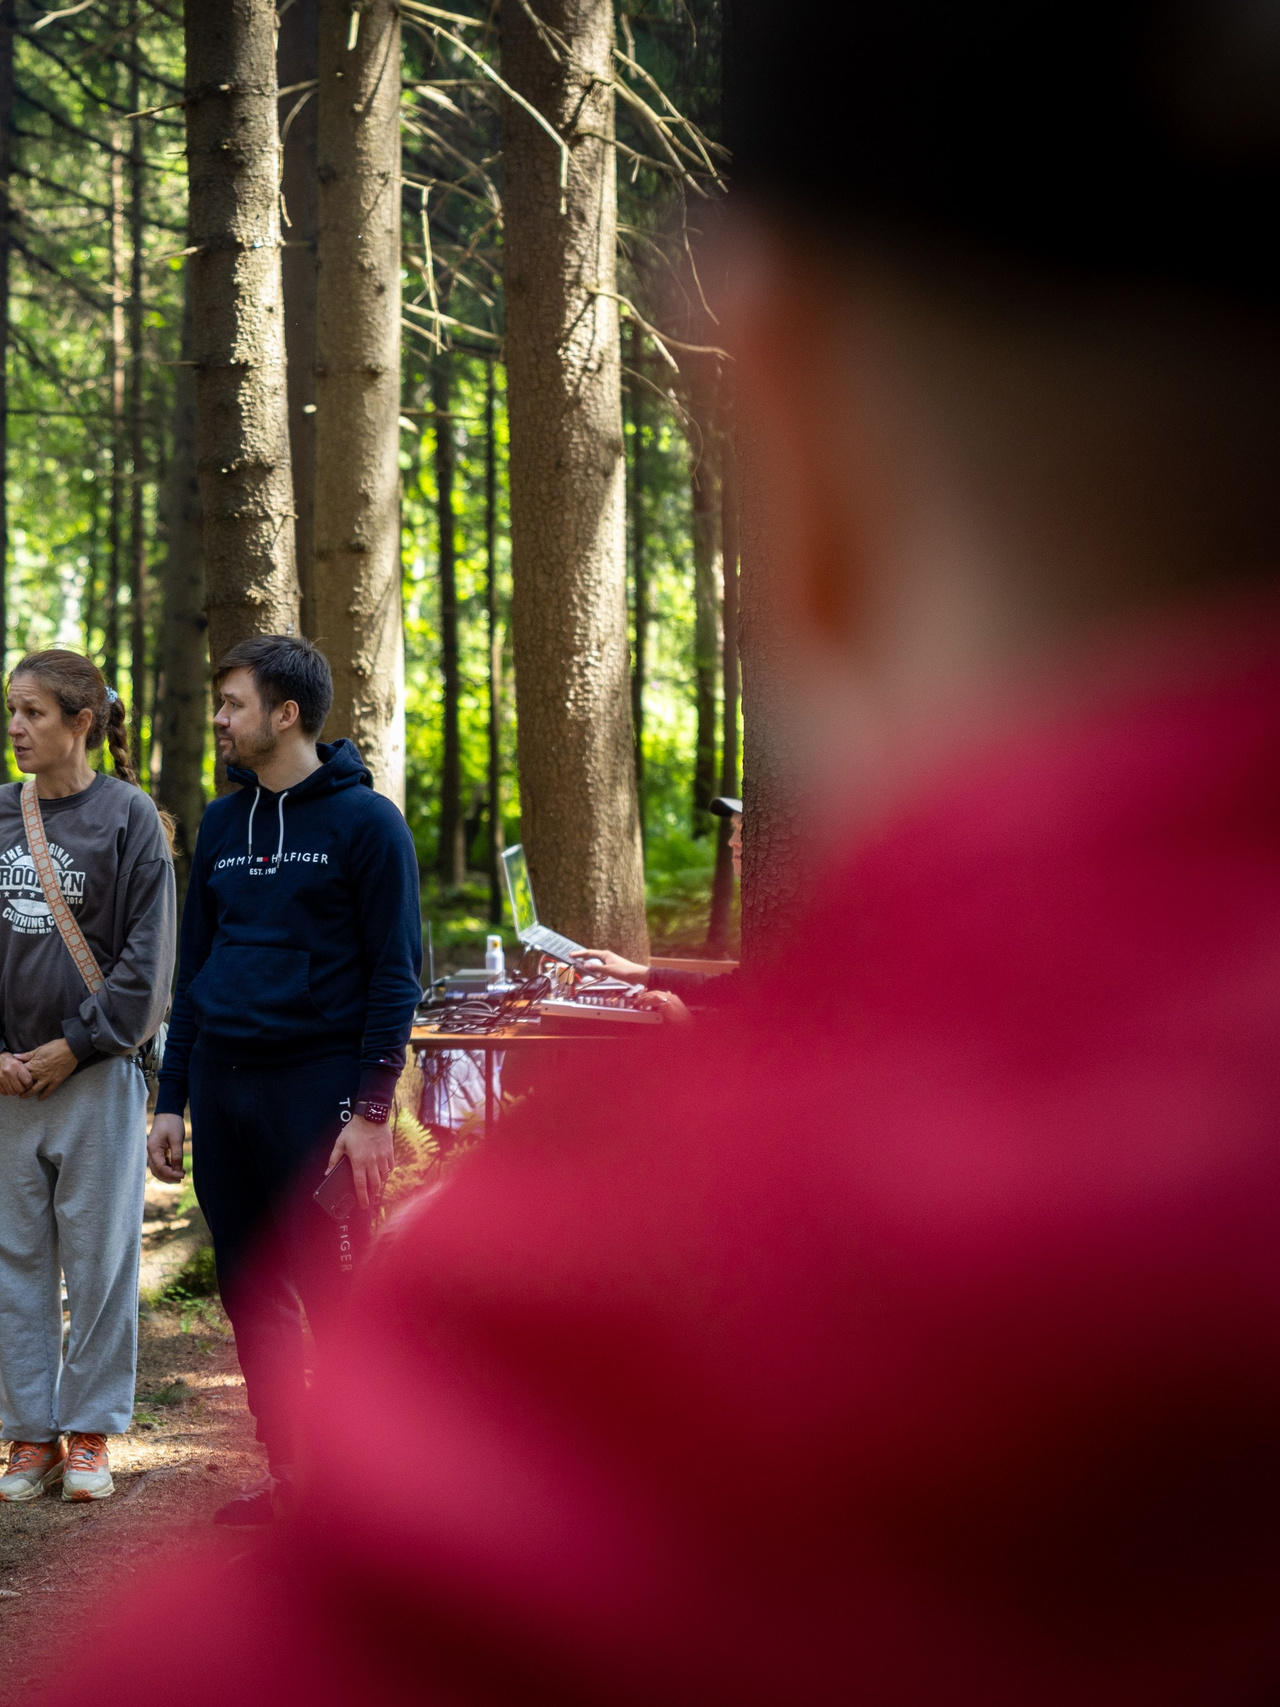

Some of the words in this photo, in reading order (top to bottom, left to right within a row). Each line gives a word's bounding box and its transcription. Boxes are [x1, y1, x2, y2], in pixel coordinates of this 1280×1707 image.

[0, 845, 24, 864] THE
[271, 852, 329, 864] HLFIGER
[66, 896, 83, 904] 2014
